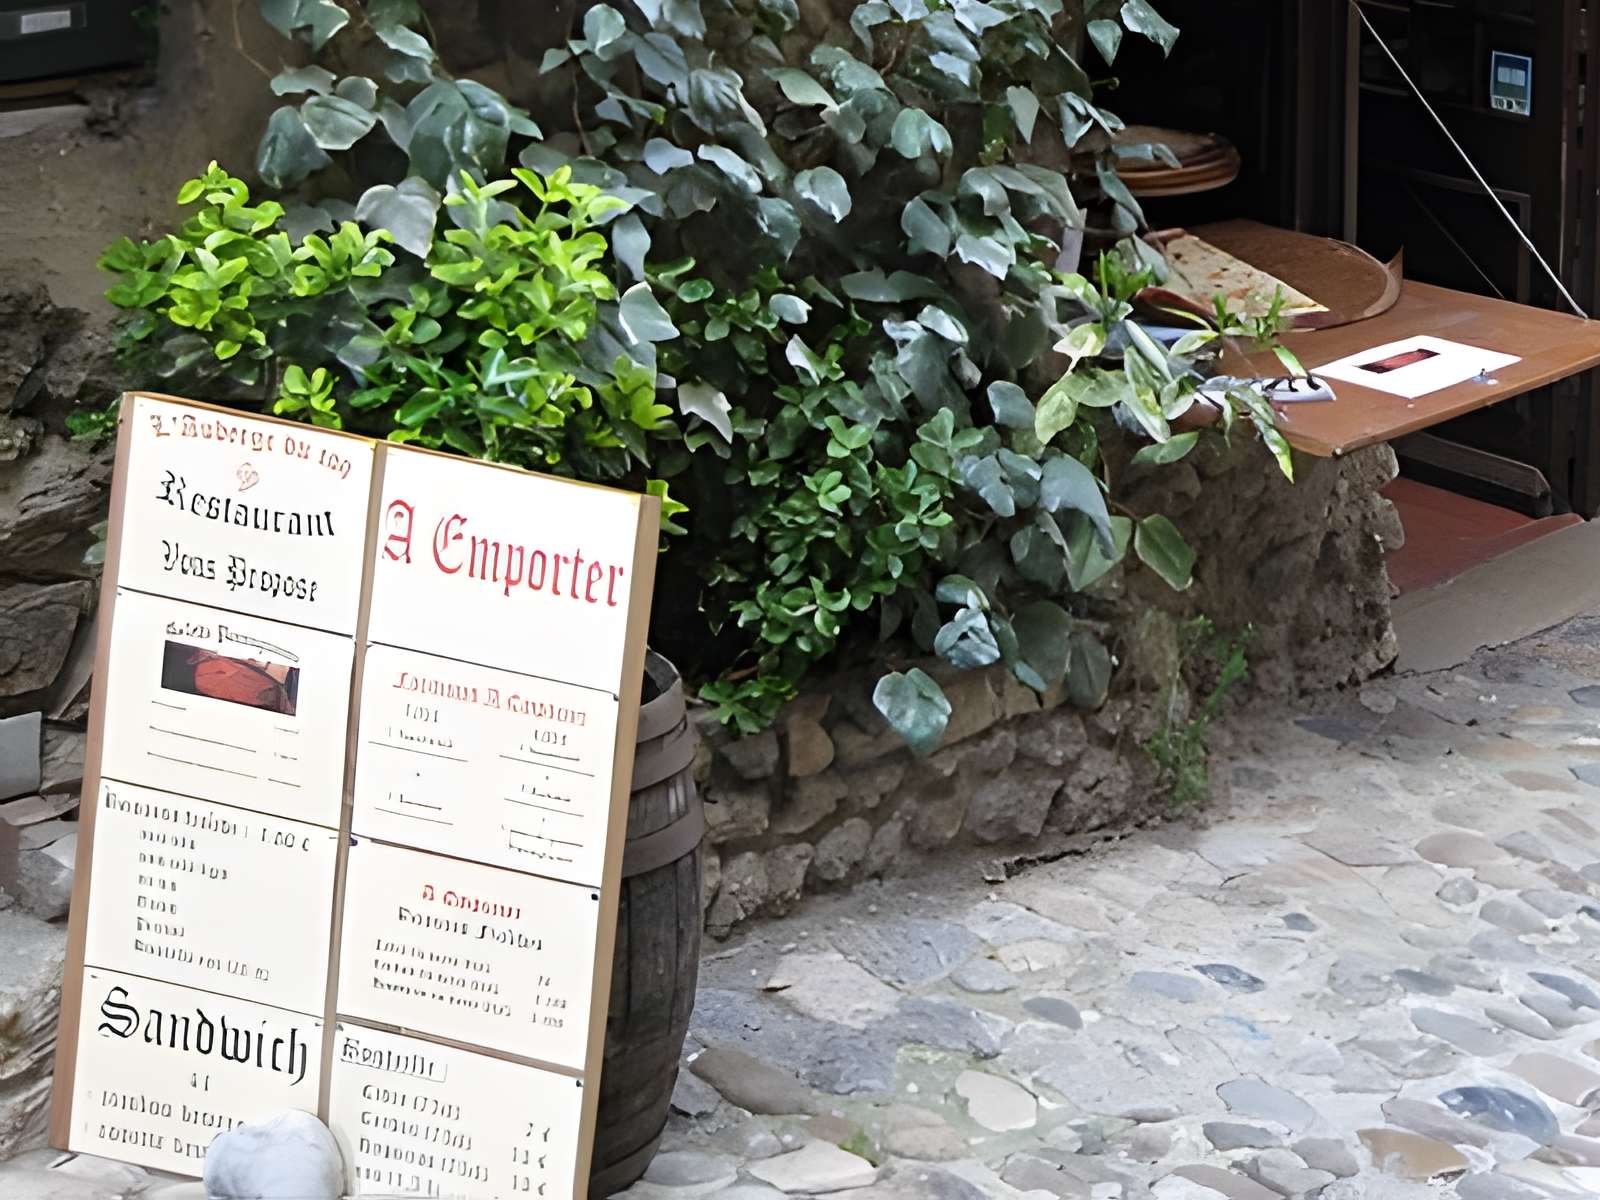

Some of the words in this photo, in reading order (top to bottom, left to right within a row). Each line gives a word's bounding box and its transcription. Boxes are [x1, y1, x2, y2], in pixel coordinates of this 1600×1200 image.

[156, 469, 335, 536] Restaurant
[381, 499, 416, 564] A
[432, 513, 624, 607] Emporter
[98, 986, 308, 1087] Sandwich
